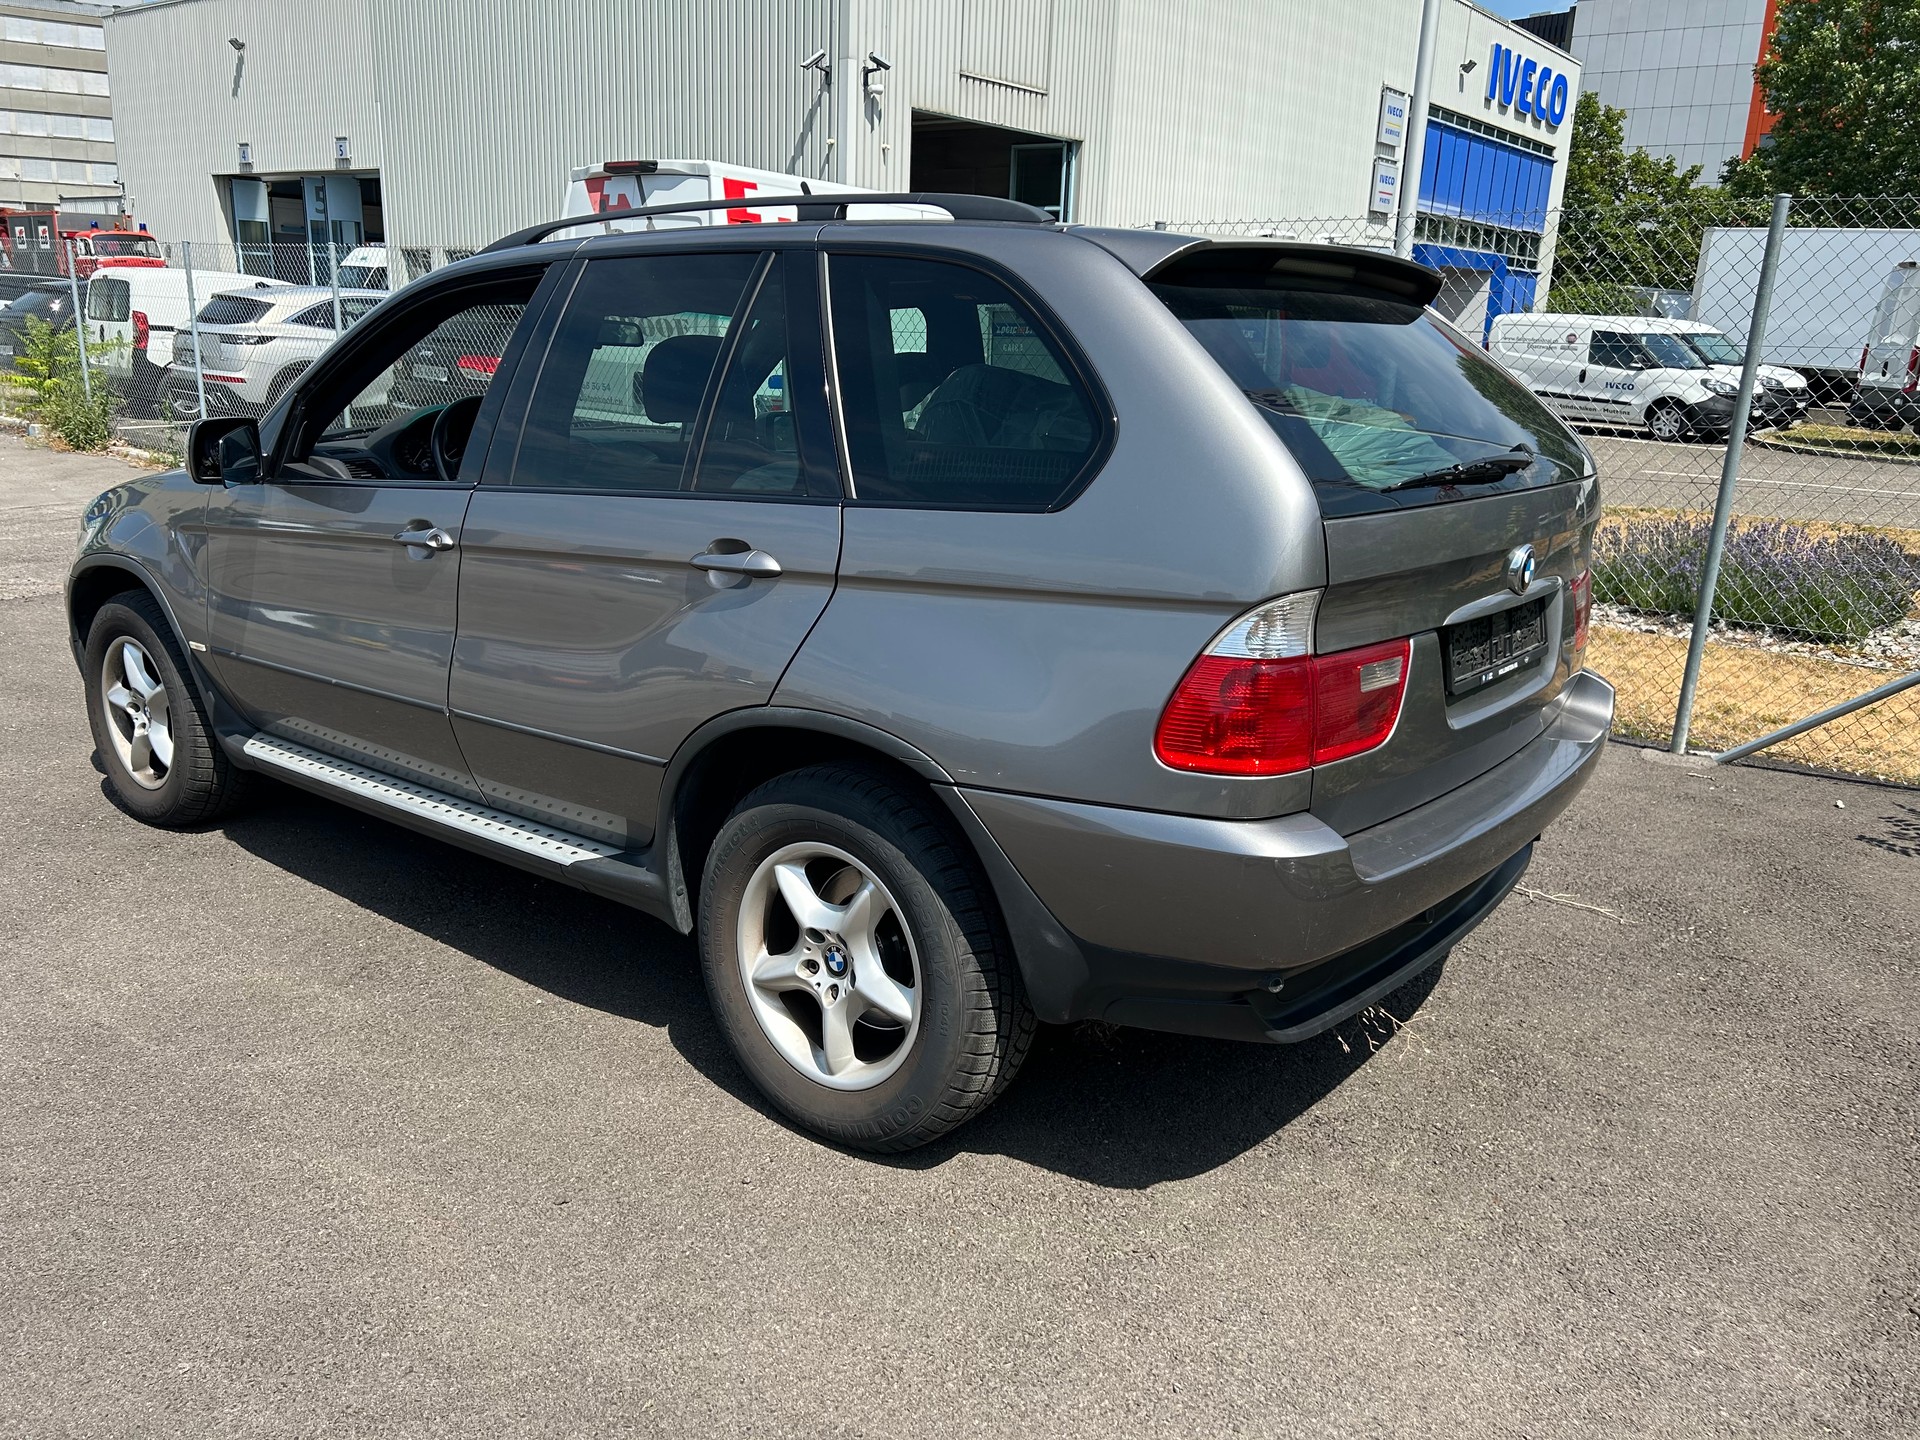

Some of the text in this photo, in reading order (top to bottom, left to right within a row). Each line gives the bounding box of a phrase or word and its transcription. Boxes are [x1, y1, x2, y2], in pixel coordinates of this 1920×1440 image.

[1487, 42, 1568, 127] IVECO
[1387, 104, 1403, 119] IVECO
[241, 149, 247, 161] 4
[338, 144, 344, 157] 5
[1379, 174, 1396, 187] IVECO
[1605, 381, 1635, 391] IVECO
